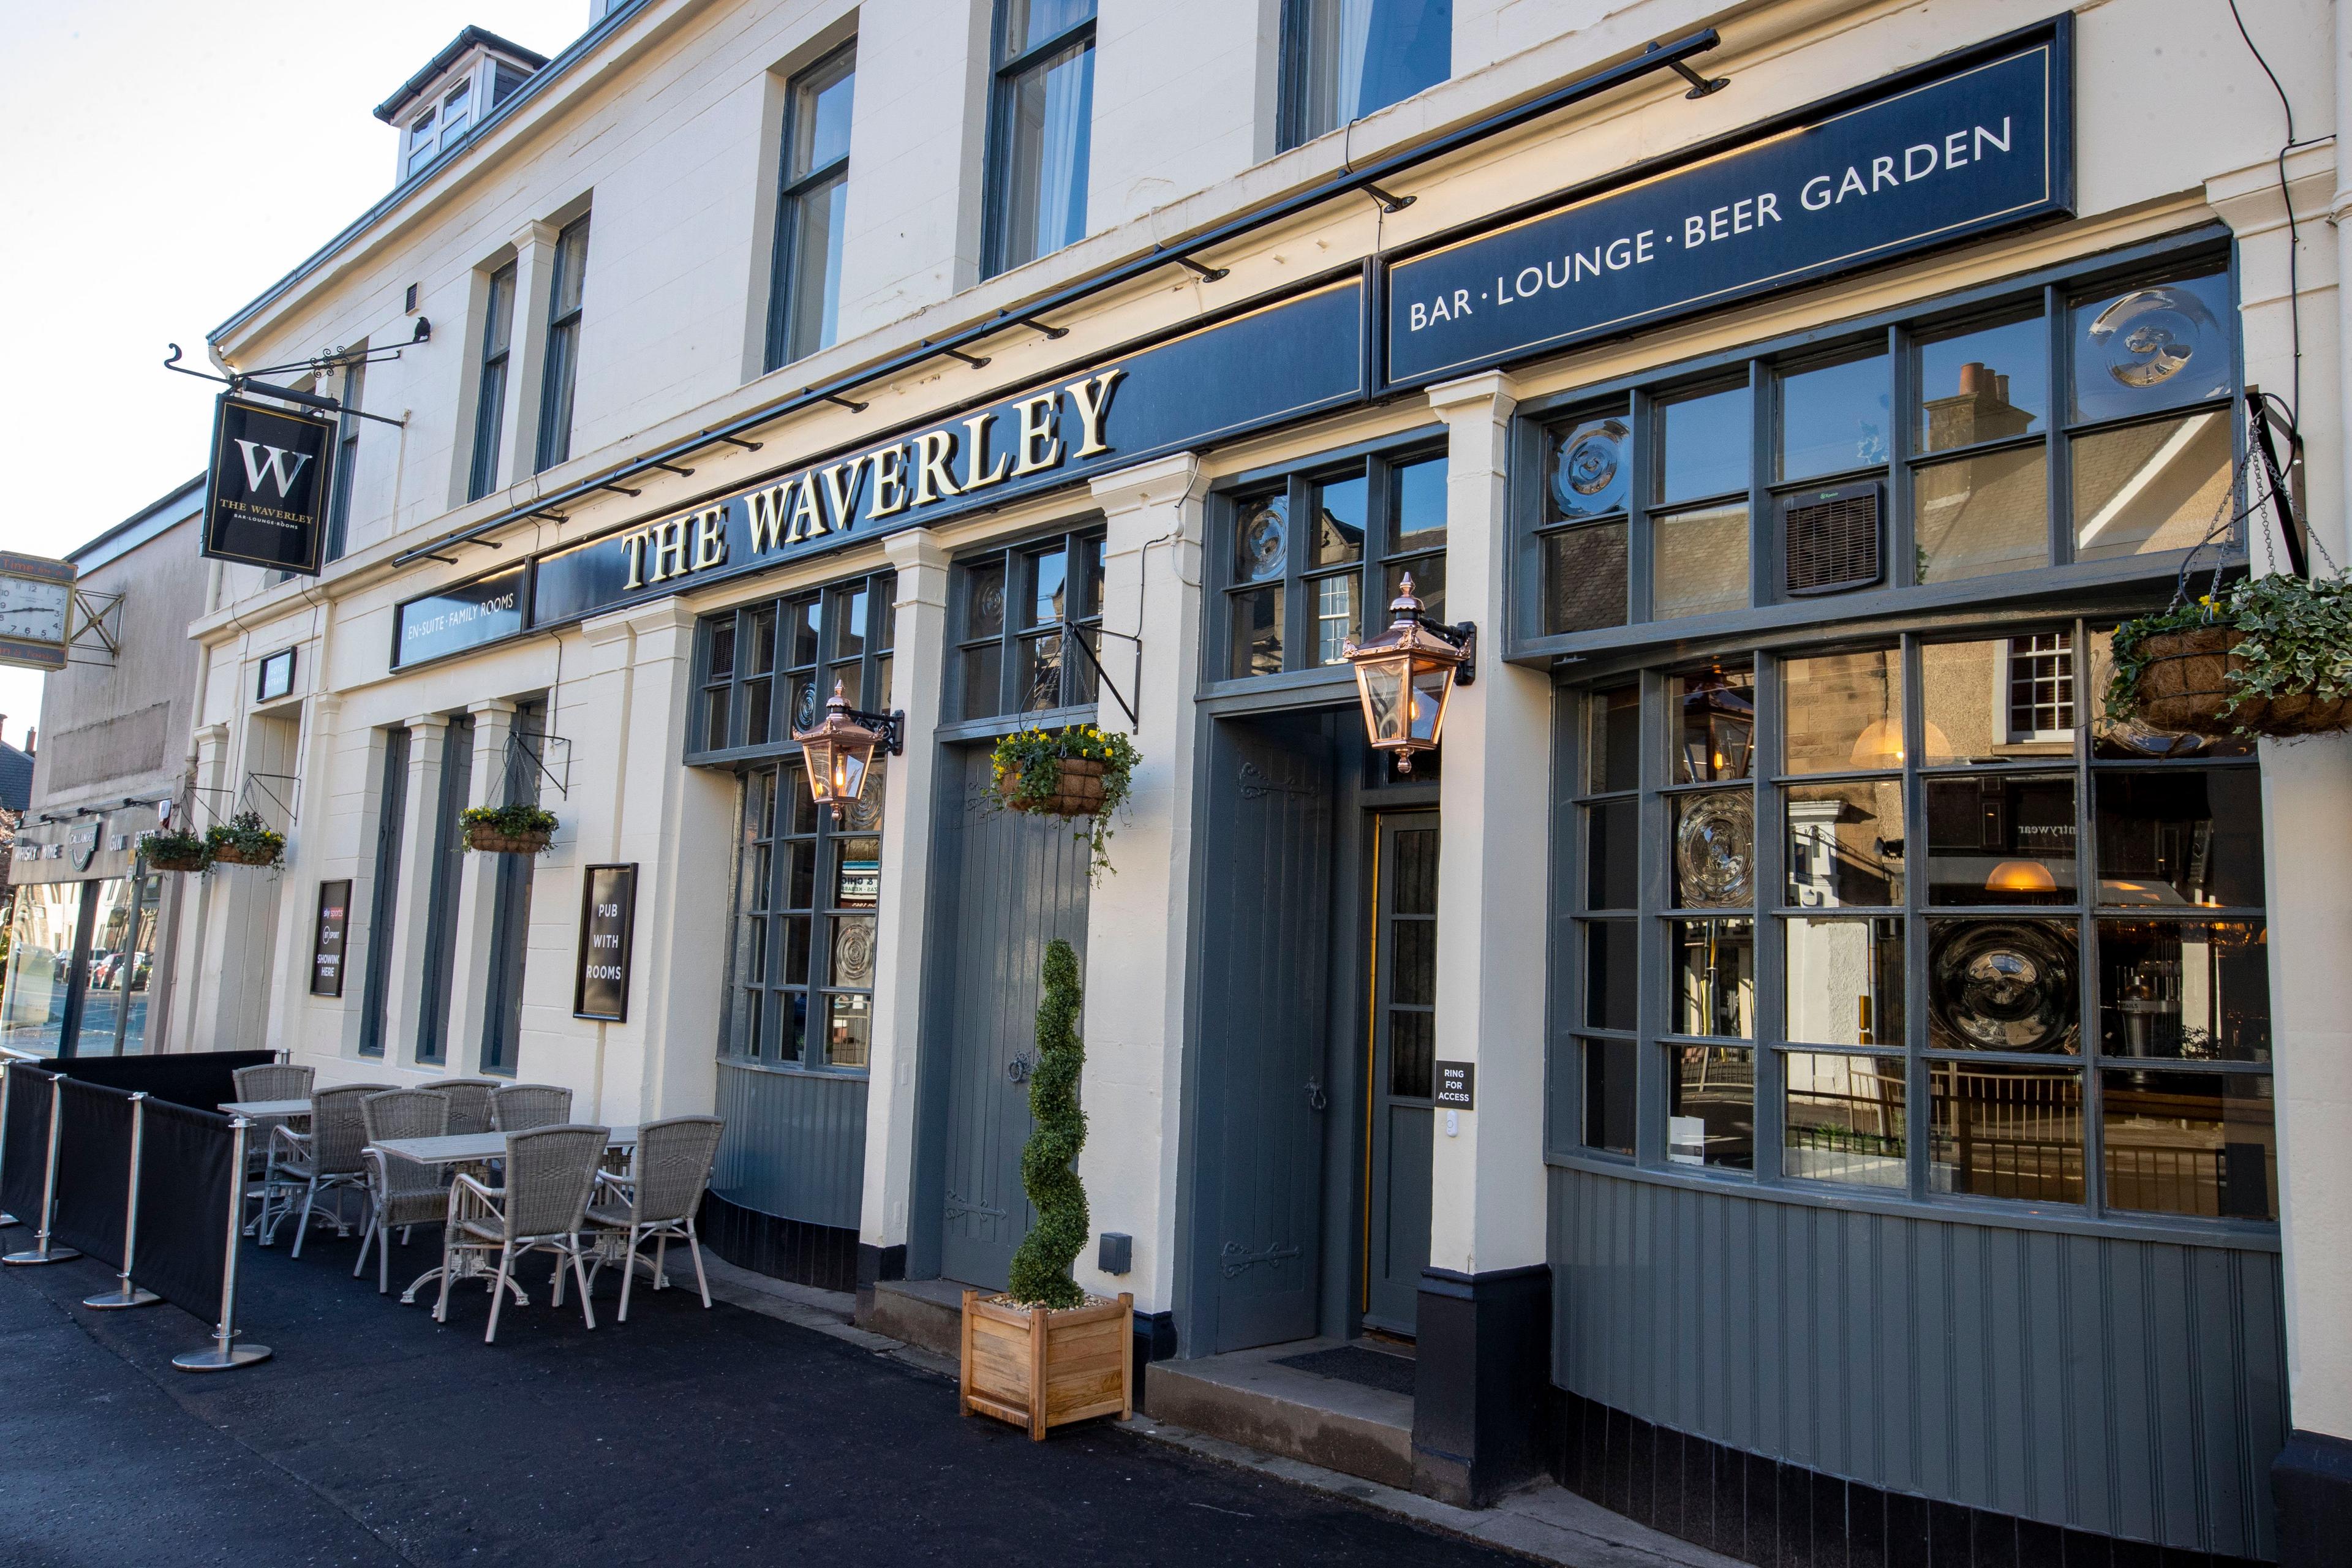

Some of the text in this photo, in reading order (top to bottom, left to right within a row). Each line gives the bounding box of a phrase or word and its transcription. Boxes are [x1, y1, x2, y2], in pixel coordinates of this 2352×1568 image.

[1410, 116, 2011, 331] BAR LOUNGE BEER GARDEN
[235, 439, 313, 498] W
[621, 368, 1120, 590] THE WAVERLEY
[221, 499, 314, 524] THE WAVERLEY
[4, 559, 33, 573] Time
[448, 603, 479, 628] FAMILY
[480, 592, 514, 617] ROOMS
[69, 831, 95, 845] CALLANDER
[110, 833, 123, 852] GIN
[15, 846, 37, 862] WHISKY
[42, 843, 59, 860] WINE
[330, 908, 343, 920] sports
[598, 903, 617, 918] PUB
[594, 934, 619, 948] WITH
[321, 967, 334, 977] HERE
[586, 965, 622, 980] ROOMS
[1444, 1069, 1464, 1078] RING
[1446, 1081, 1463, 1090] FOR
[1438, 1091, 1469, 1102] ACCESS
